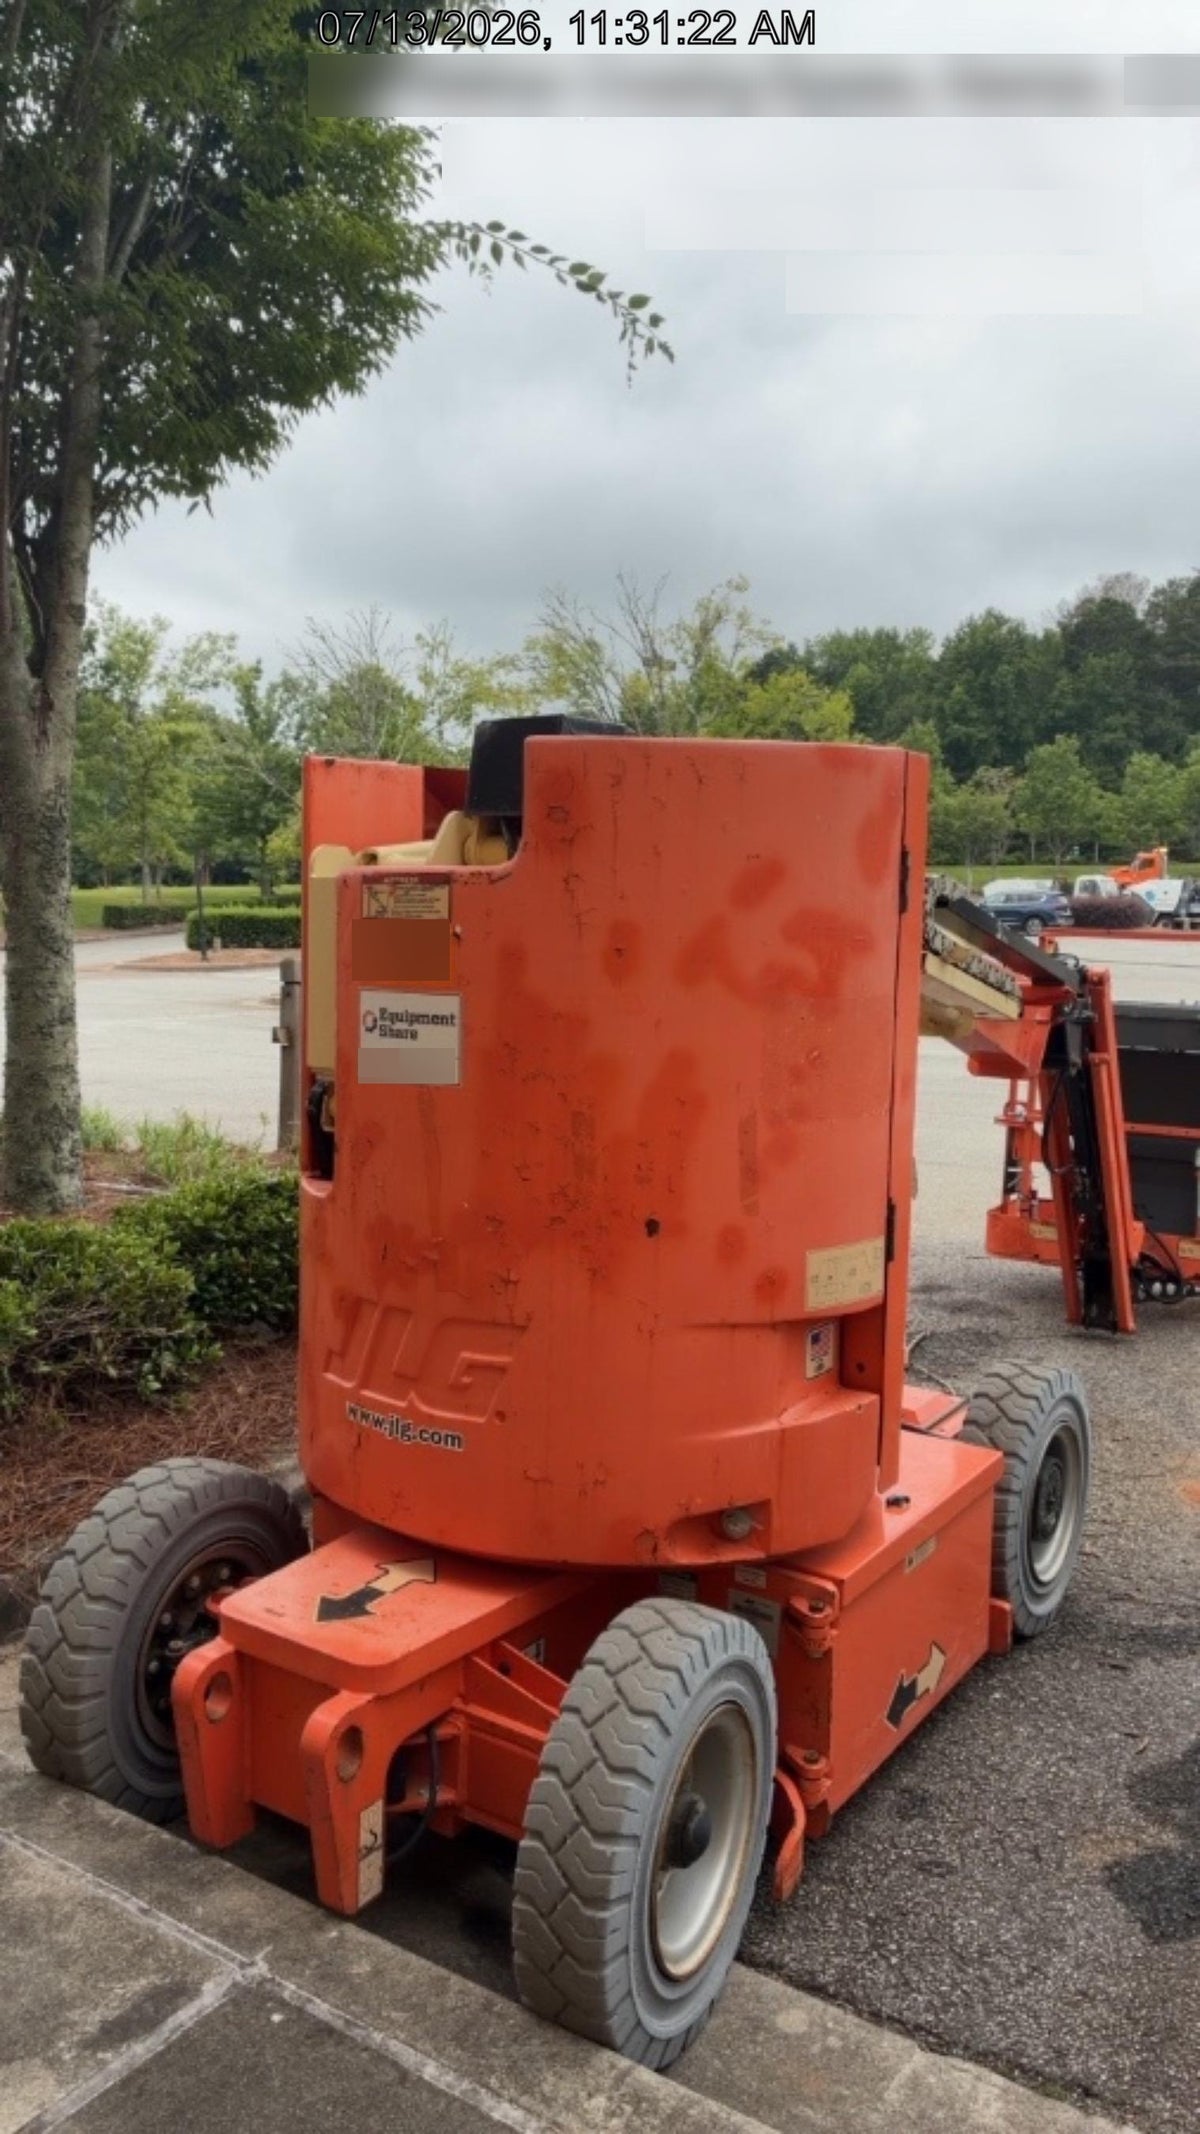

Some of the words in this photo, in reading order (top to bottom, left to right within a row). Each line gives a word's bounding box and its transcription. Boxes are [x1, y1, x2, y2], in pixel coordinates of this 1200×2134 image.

[378, 1007, 456, 1028] Equipment
[378, 1023, 419, 1041] Share
[322, 1295, 529, 1424] JLG
[345, 1400, 464, 1452] www.jlg.com
